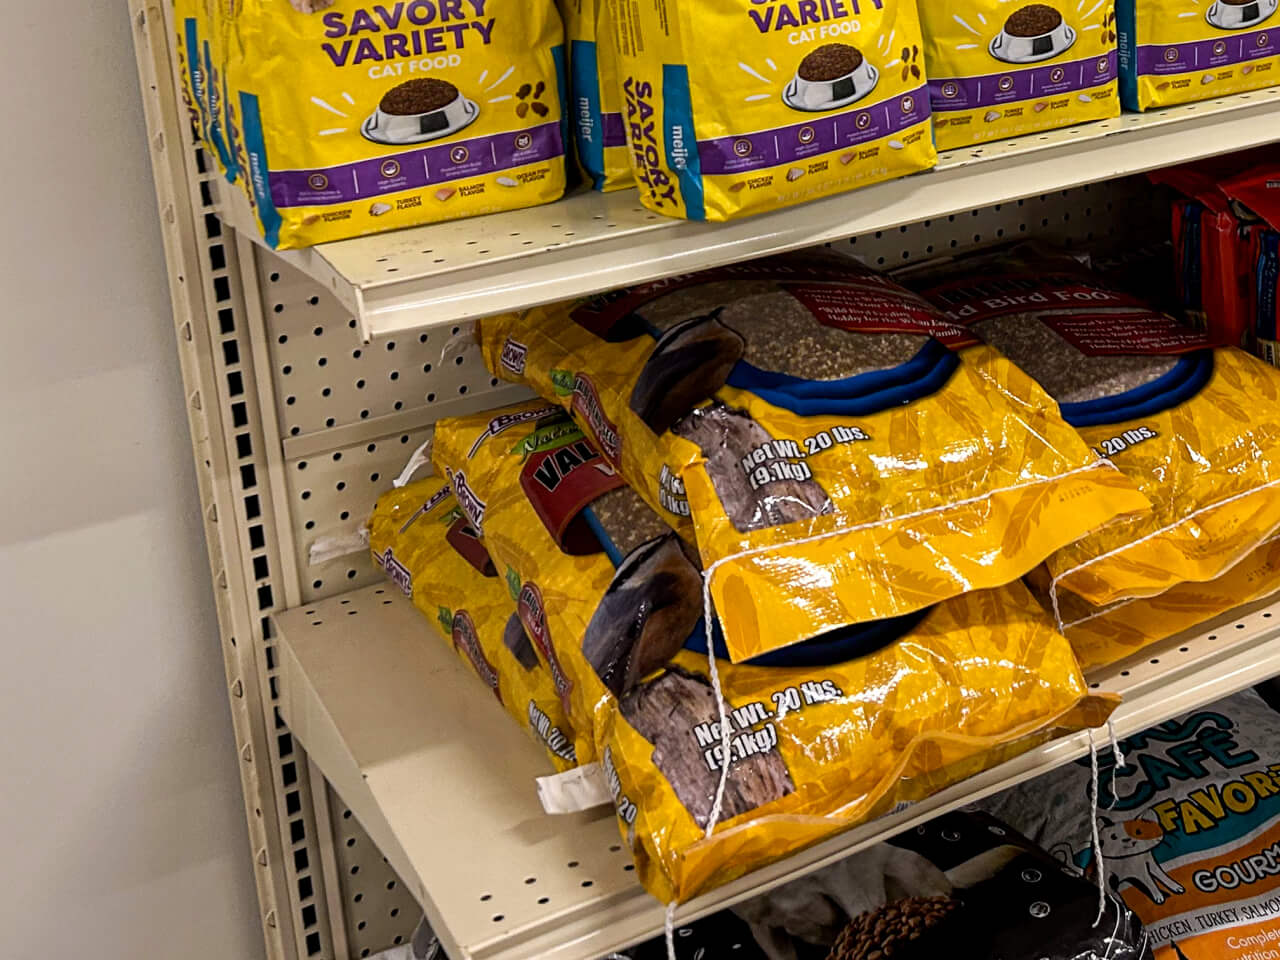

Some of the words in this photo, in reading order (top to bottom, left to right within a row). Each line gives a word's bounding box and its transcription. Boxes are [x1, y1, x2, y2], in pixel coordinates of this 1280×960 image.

[321, 18, 496, 68] VARIETY
[788, 27, 819, 46] CAT
[821, 20, 861, 41] FOOD
[368, 60, 406, 80] CAT
[408, 54, 462, 75] FOOD
[578, 96, 593, 143] meijer
[742, 443, 774, 475] Net
[776, 437, 806, 463] Wt.
[807, 431, 831, 455] 20
[832, 424, 869, 447] lbs.
[749, 460, 813, 492] (9.1kg)
